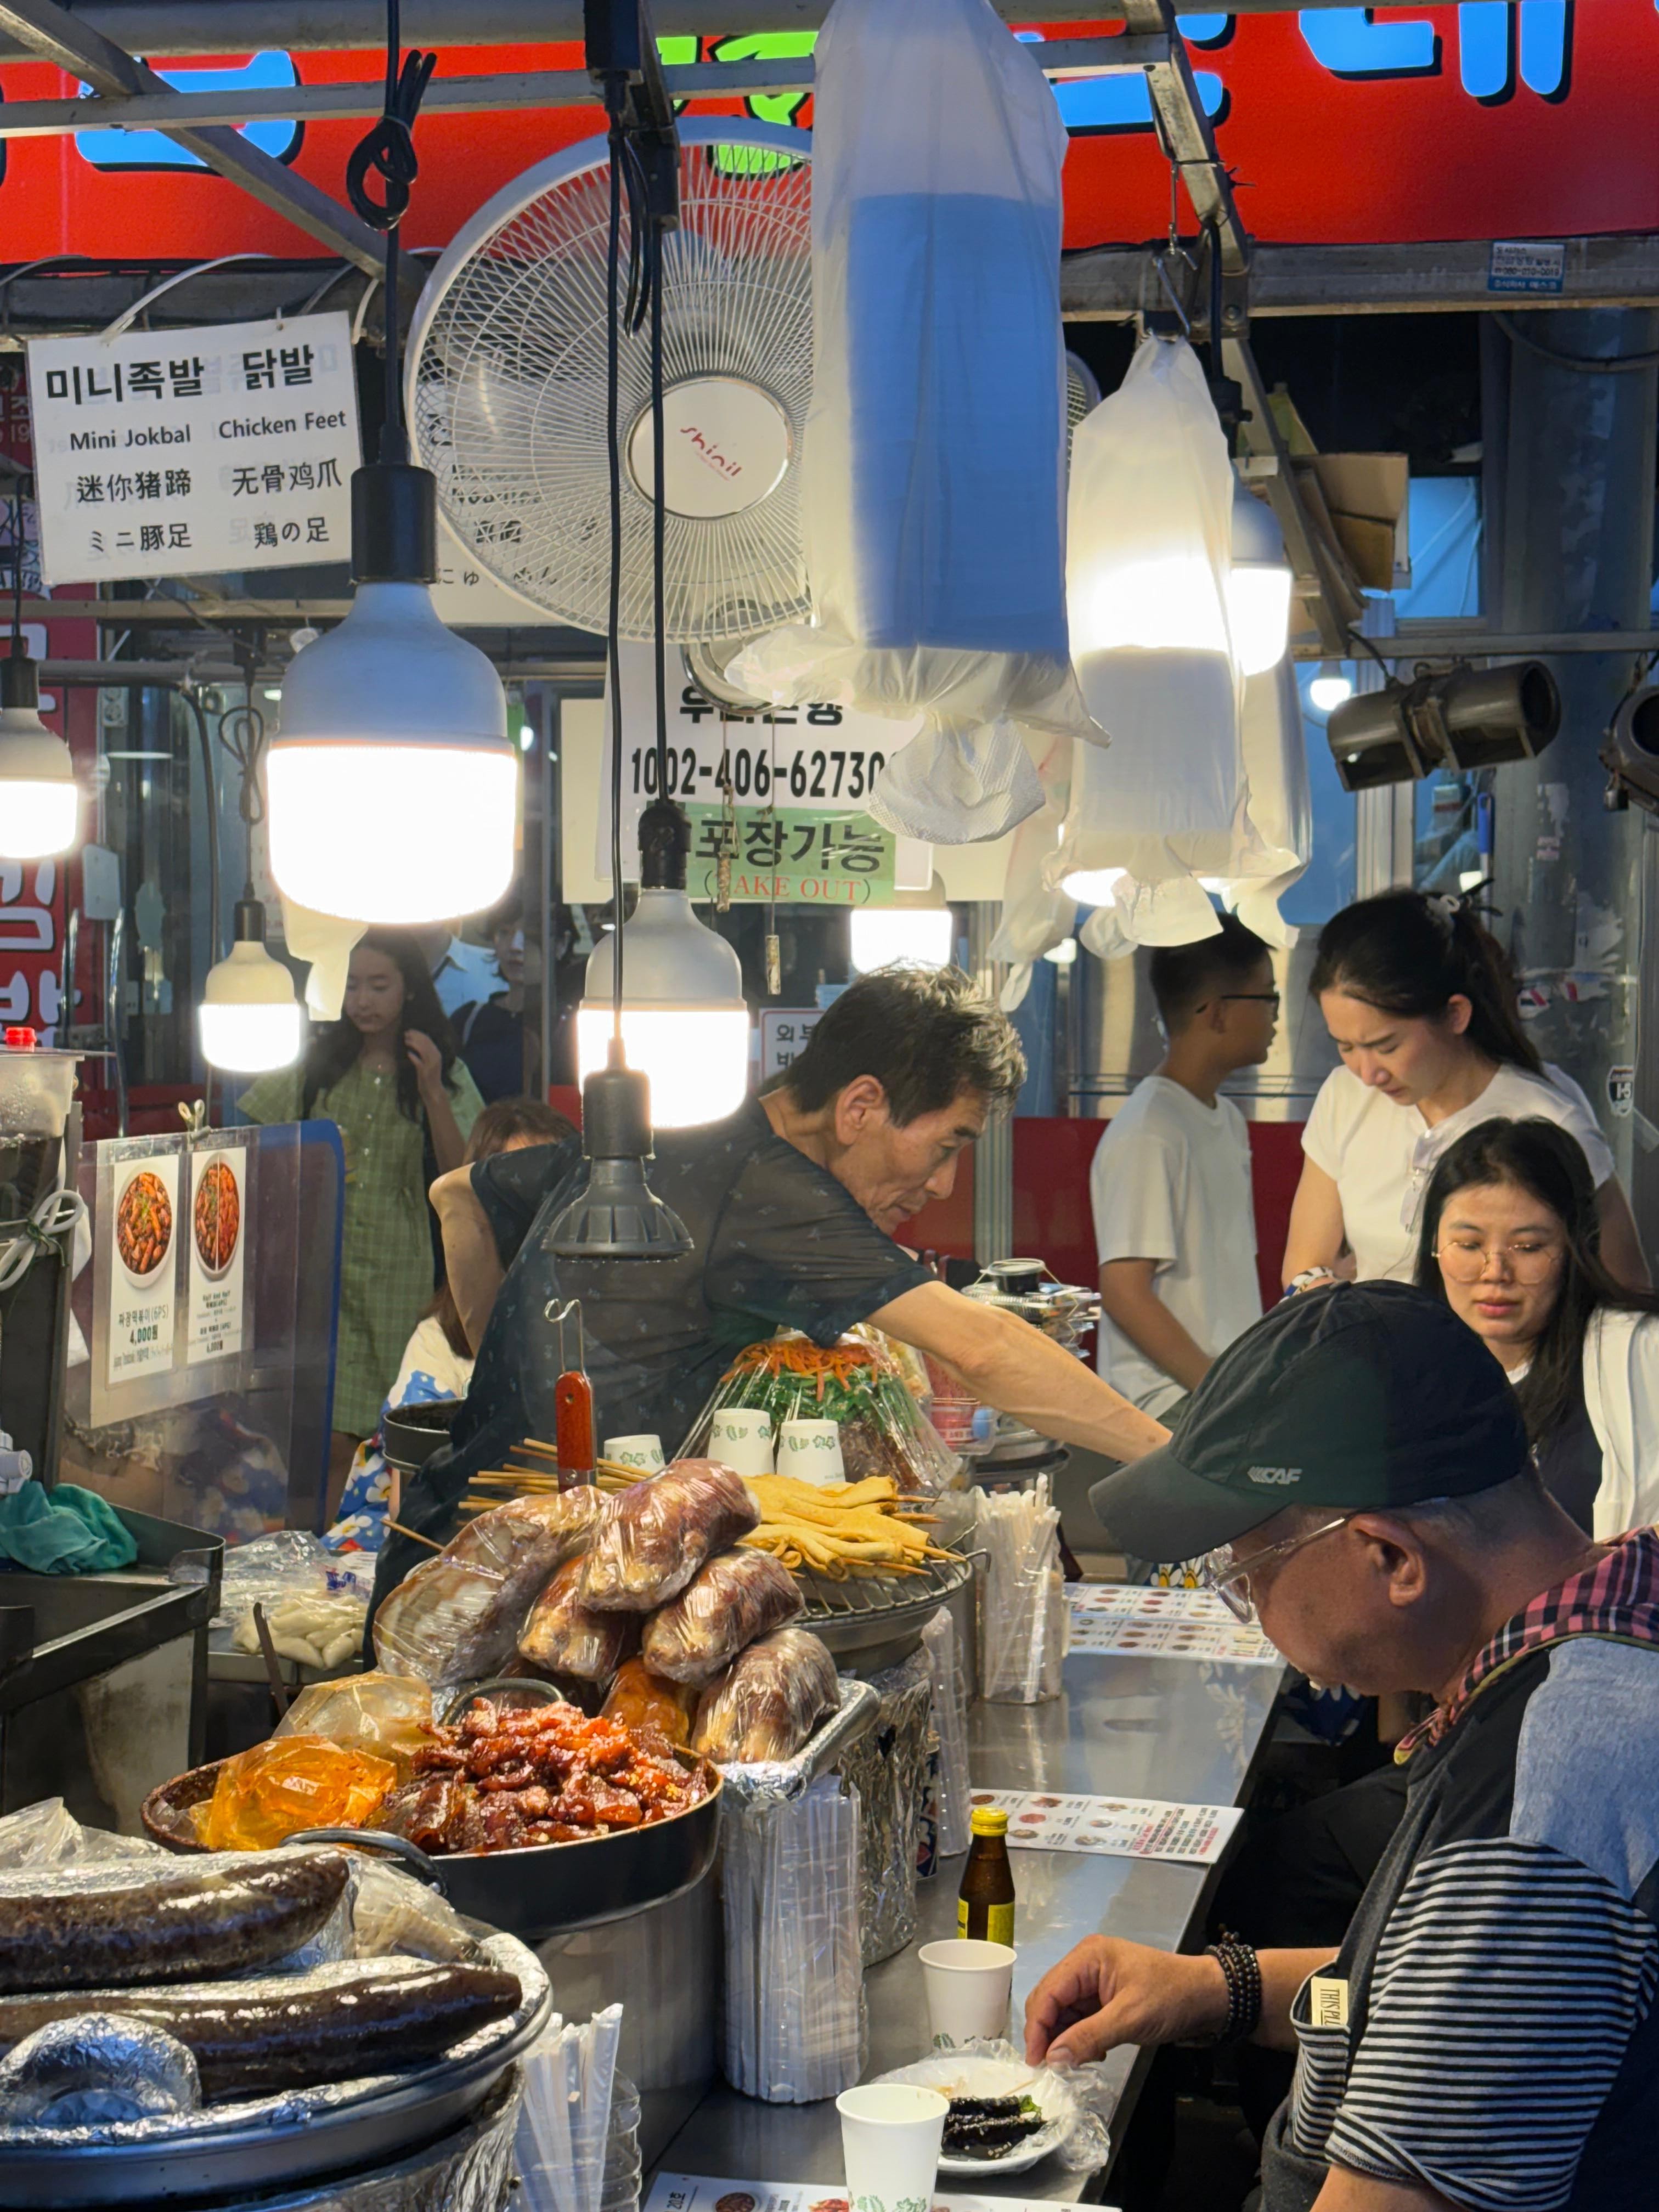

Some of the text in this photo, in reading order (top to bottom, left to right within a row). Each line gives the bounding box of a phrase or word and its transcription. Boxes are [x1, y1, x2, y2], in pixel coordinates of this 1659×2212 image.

[47, 357, 204, 405] 미니족발
[242, 345, 314, 390] 닭발
[70, 425, 190, 450] Mini Jokbal
[219, 411, 347, 438] Chicken Feet
[77, 469, 191, 503] 迷你猪蹄
[232, 458, 342, 496] 无骨鸡爪
[92, 523, 192, 552] ミニ豚足
[254, 517, 329, 549] 鶏の足
[695, 819, 885, 873] 포장가능
[129, 1324, 158, 1346] 4,000원
[1320, 1988, 1340, 2010] THIS
